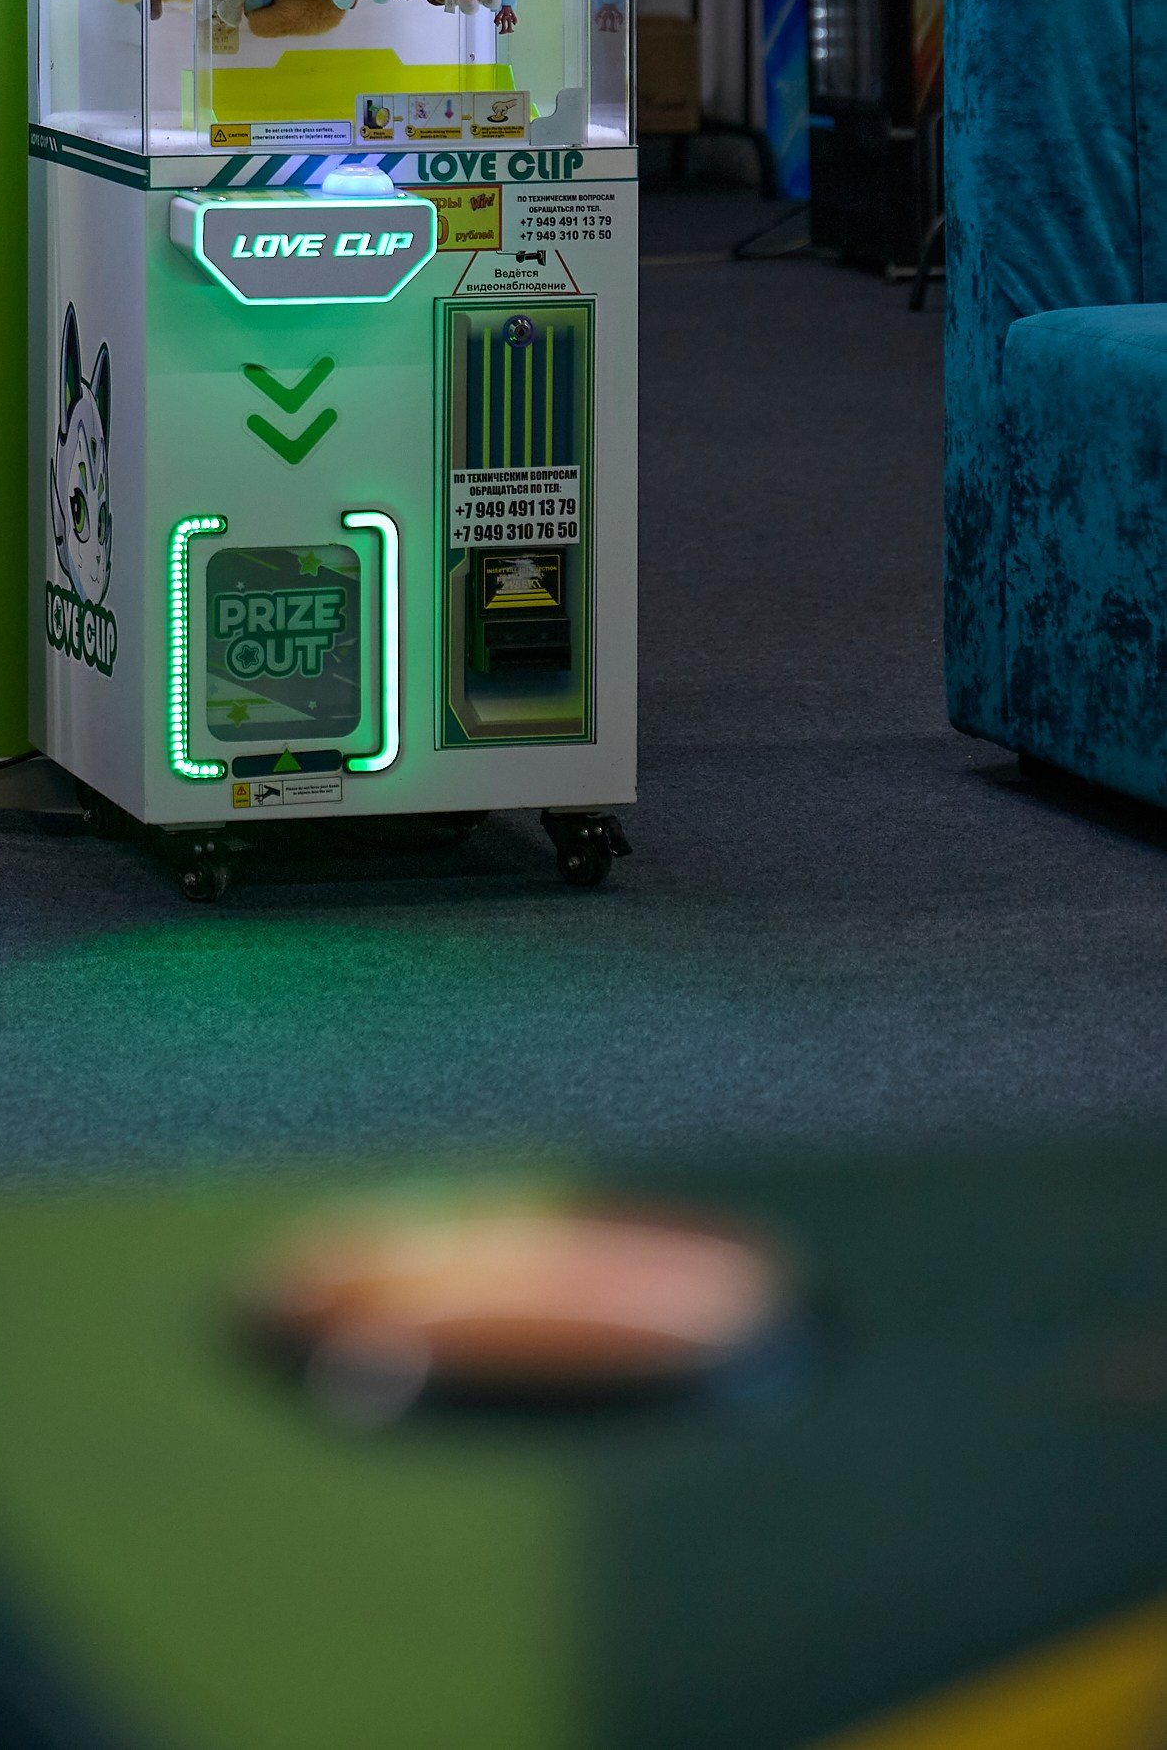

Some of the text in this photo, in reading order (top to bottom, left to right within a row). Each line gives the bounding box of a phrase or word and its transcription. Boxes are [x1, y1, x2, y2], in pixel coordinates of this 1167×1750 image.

[418, 150, 583, 182] LOVE CLIP
[529, 205, 574, 214] ОБРАЩАТЬСЯ
[520, 216, 612, 227] +7 949 491 13 79
[520, 230, 612, 241] +7 949 310 76 50
[233, 232, 414, 258] LOVE CLIP
[494, 268, 539, 279] Ведётся
[466, 281, 566, 292] видеонаблюдение
[454, 470, 578, 484] ПО ТЕХНИЧЕСКИМ ВОПРОСАМ
[470, 483, 562, 496] ОБРАЩАТЬСЯ ПО ТЕЛ:
[455, 498, 576, 519] +7 949 491 13 79
[453, 521, 578, 542] +7 949 310 76 50
[220, 594, 341, 634] PRIZE
[47, 591, 114, 666] LOVE CLIP
[231, 635, 329, 674] OUT
